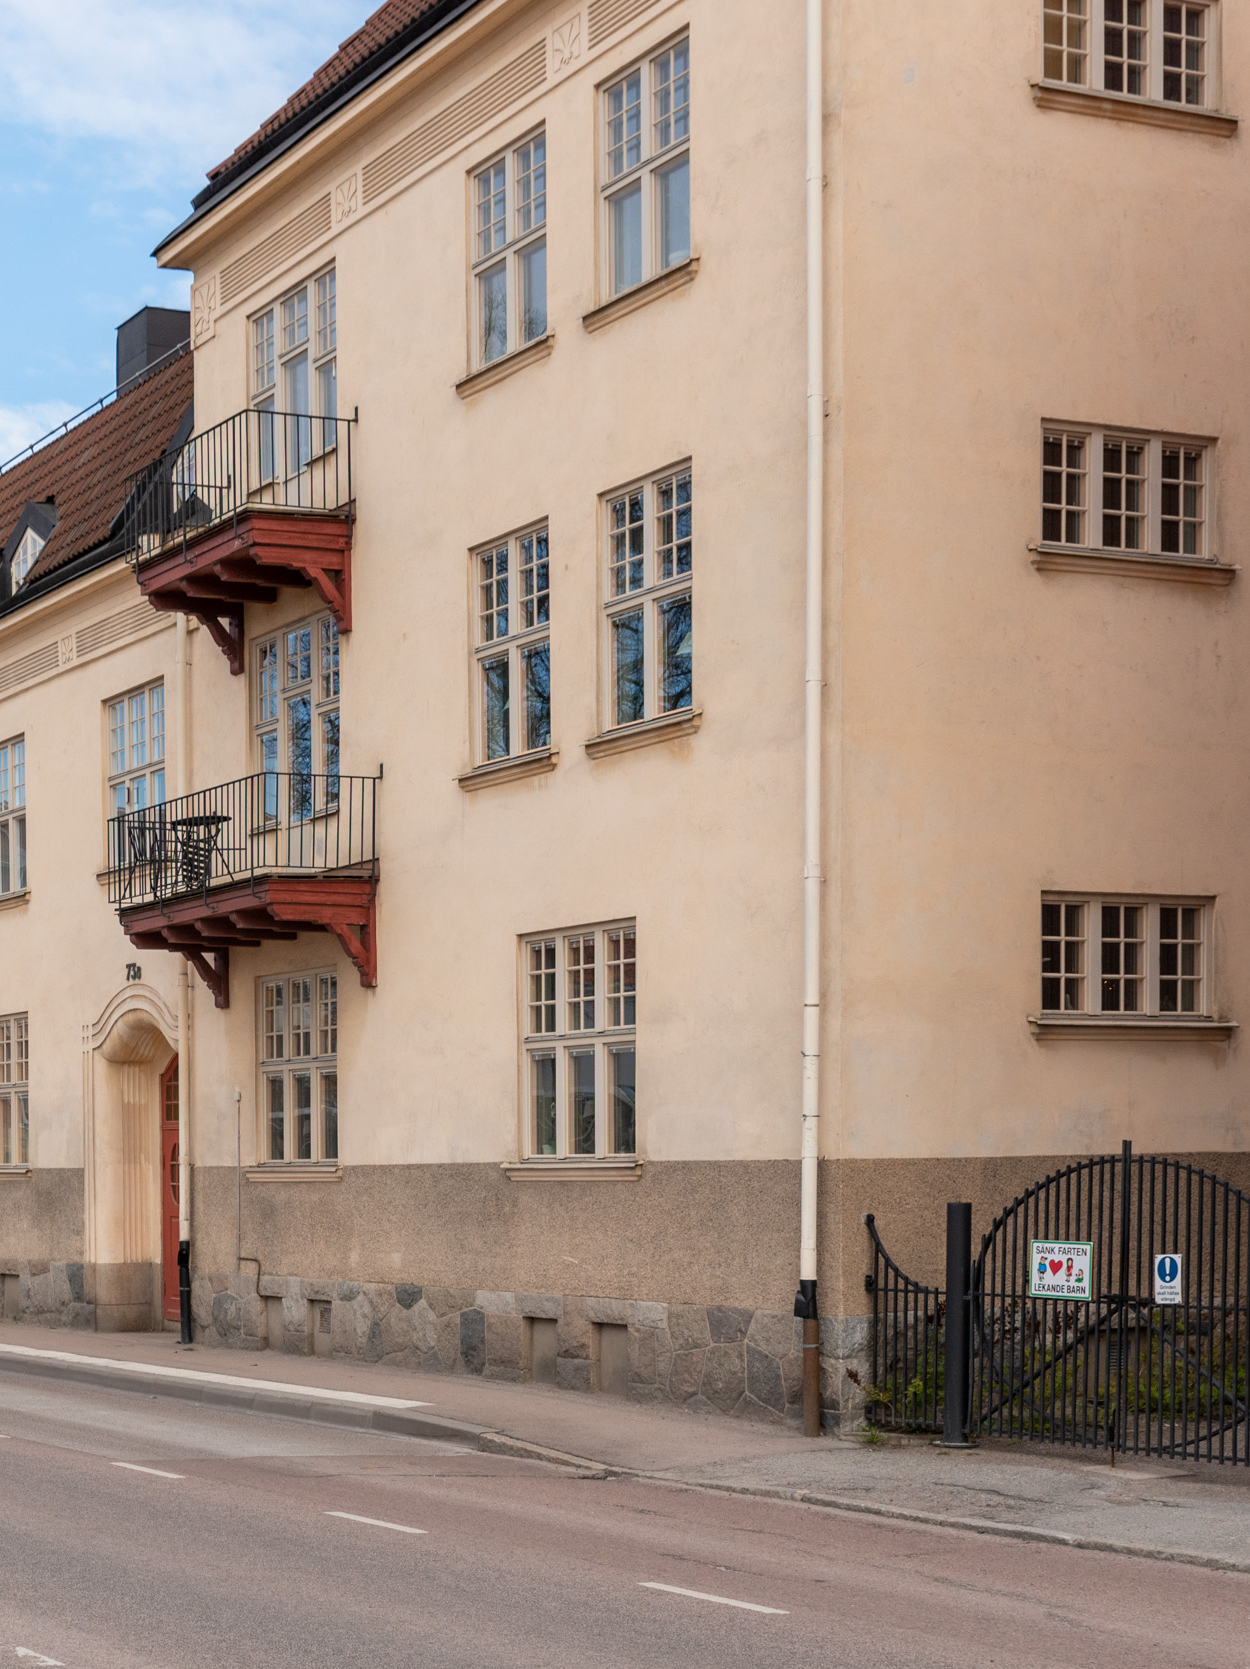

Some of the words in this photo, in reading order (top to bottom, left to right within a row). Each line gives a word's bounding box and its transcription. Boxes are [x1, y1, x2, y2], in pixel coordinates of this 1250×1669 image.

[1035, 1244, 1056, 1255] SÄNK
[1057, 1246, 1087, 1256] FARTEN
[1034, 1283, 1065, 1293] LEKANDE
[1066, 1285, 1086, 1294] BARN
